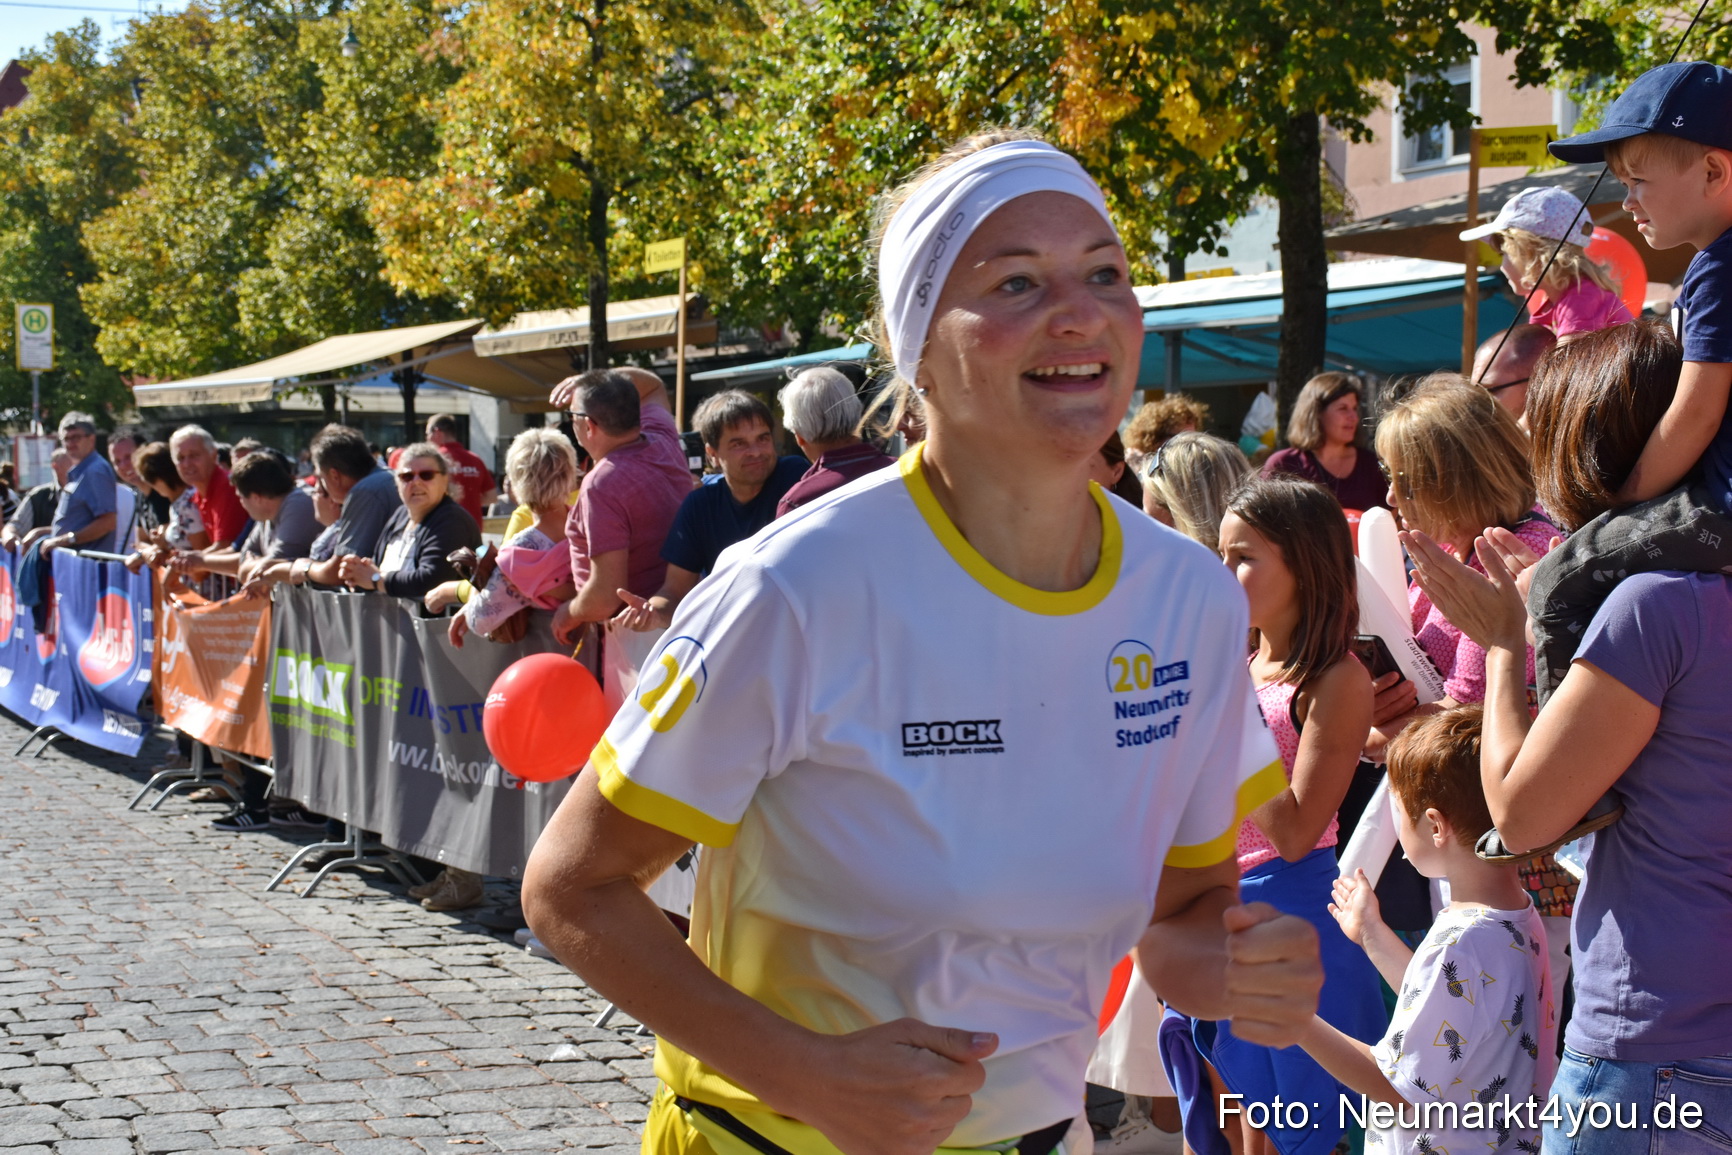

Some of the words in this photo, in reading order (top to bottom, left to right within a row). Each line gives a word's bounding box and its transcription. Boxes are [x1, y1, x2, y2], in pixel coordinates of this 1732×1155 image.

[1112, 654, 1153, 693] 20
[903, 720, 1002, 746] BOCK
[937, 747, 946, 756] by
